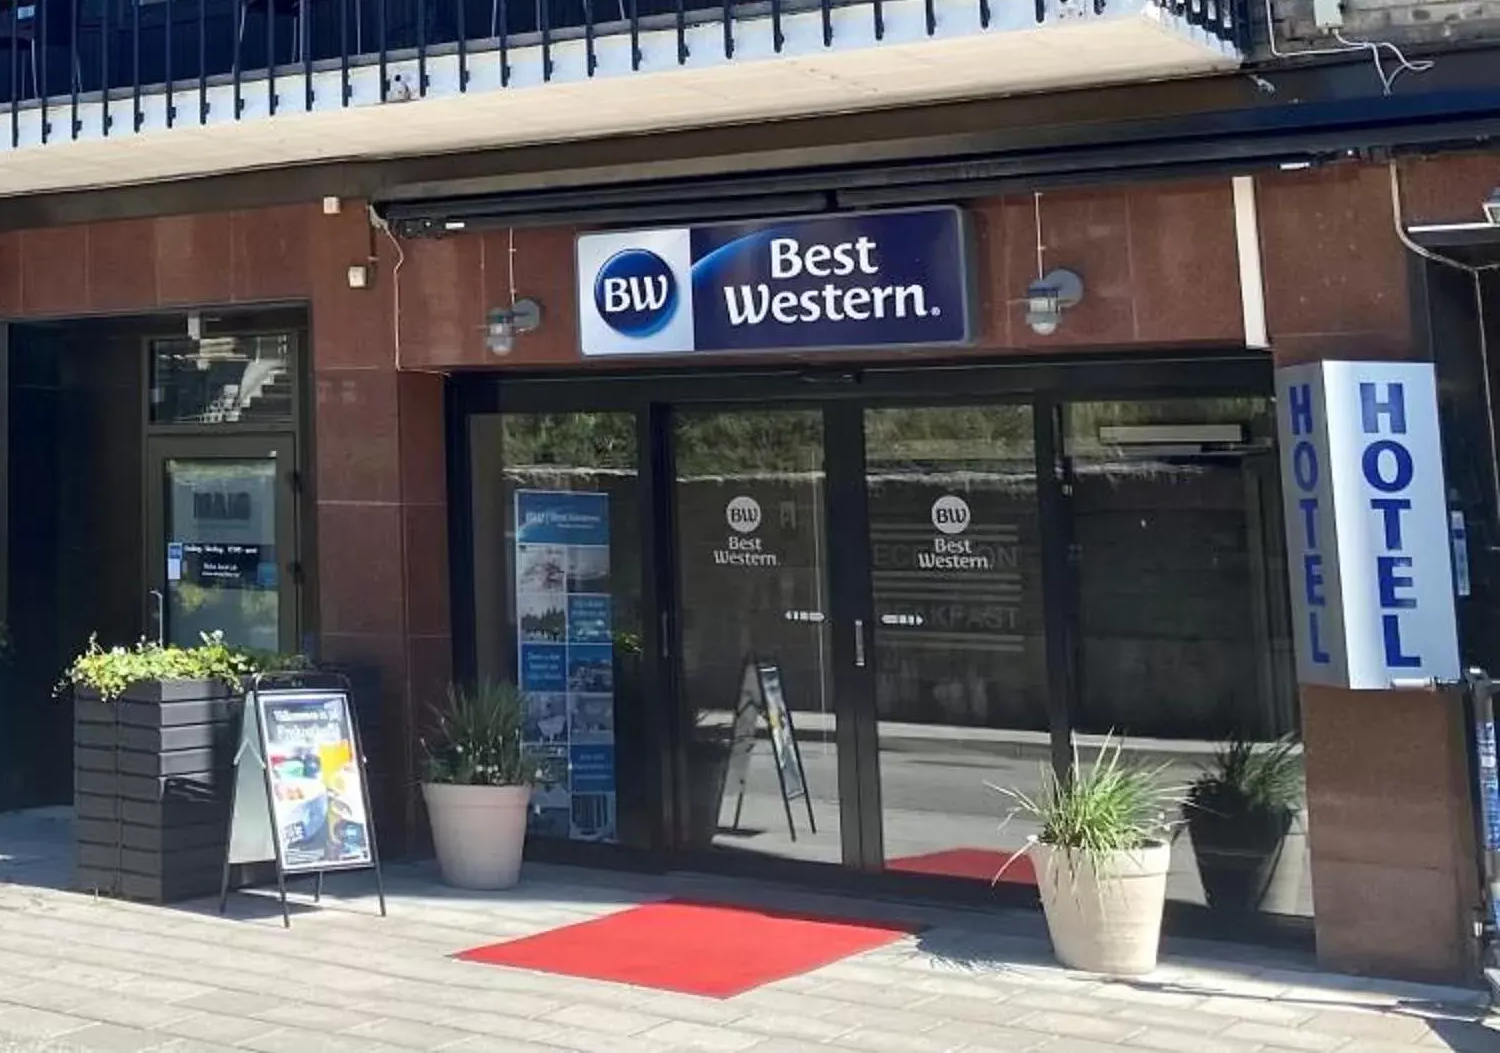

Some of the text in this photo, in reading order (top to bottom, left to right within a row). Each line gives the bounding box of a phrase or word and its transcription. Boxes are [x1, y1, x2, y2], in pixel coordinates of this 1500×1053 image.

[769, 236, 879, 280] Best
[603, 275, 669, 313] BW
[723, 282, 928, 327] Western
[730, 507, 759, 524] BW
[936, 507, 967, 525] BW
[1288, 383, 1330, 664] HOTEL
[1359, 382, 1422, 668] HOTEL
[728, 536, 762, 550] Best
[934, 537, 972, 554] Best
[713, 549, 778, 567] Western
[916, 552, 989, 570] Western
